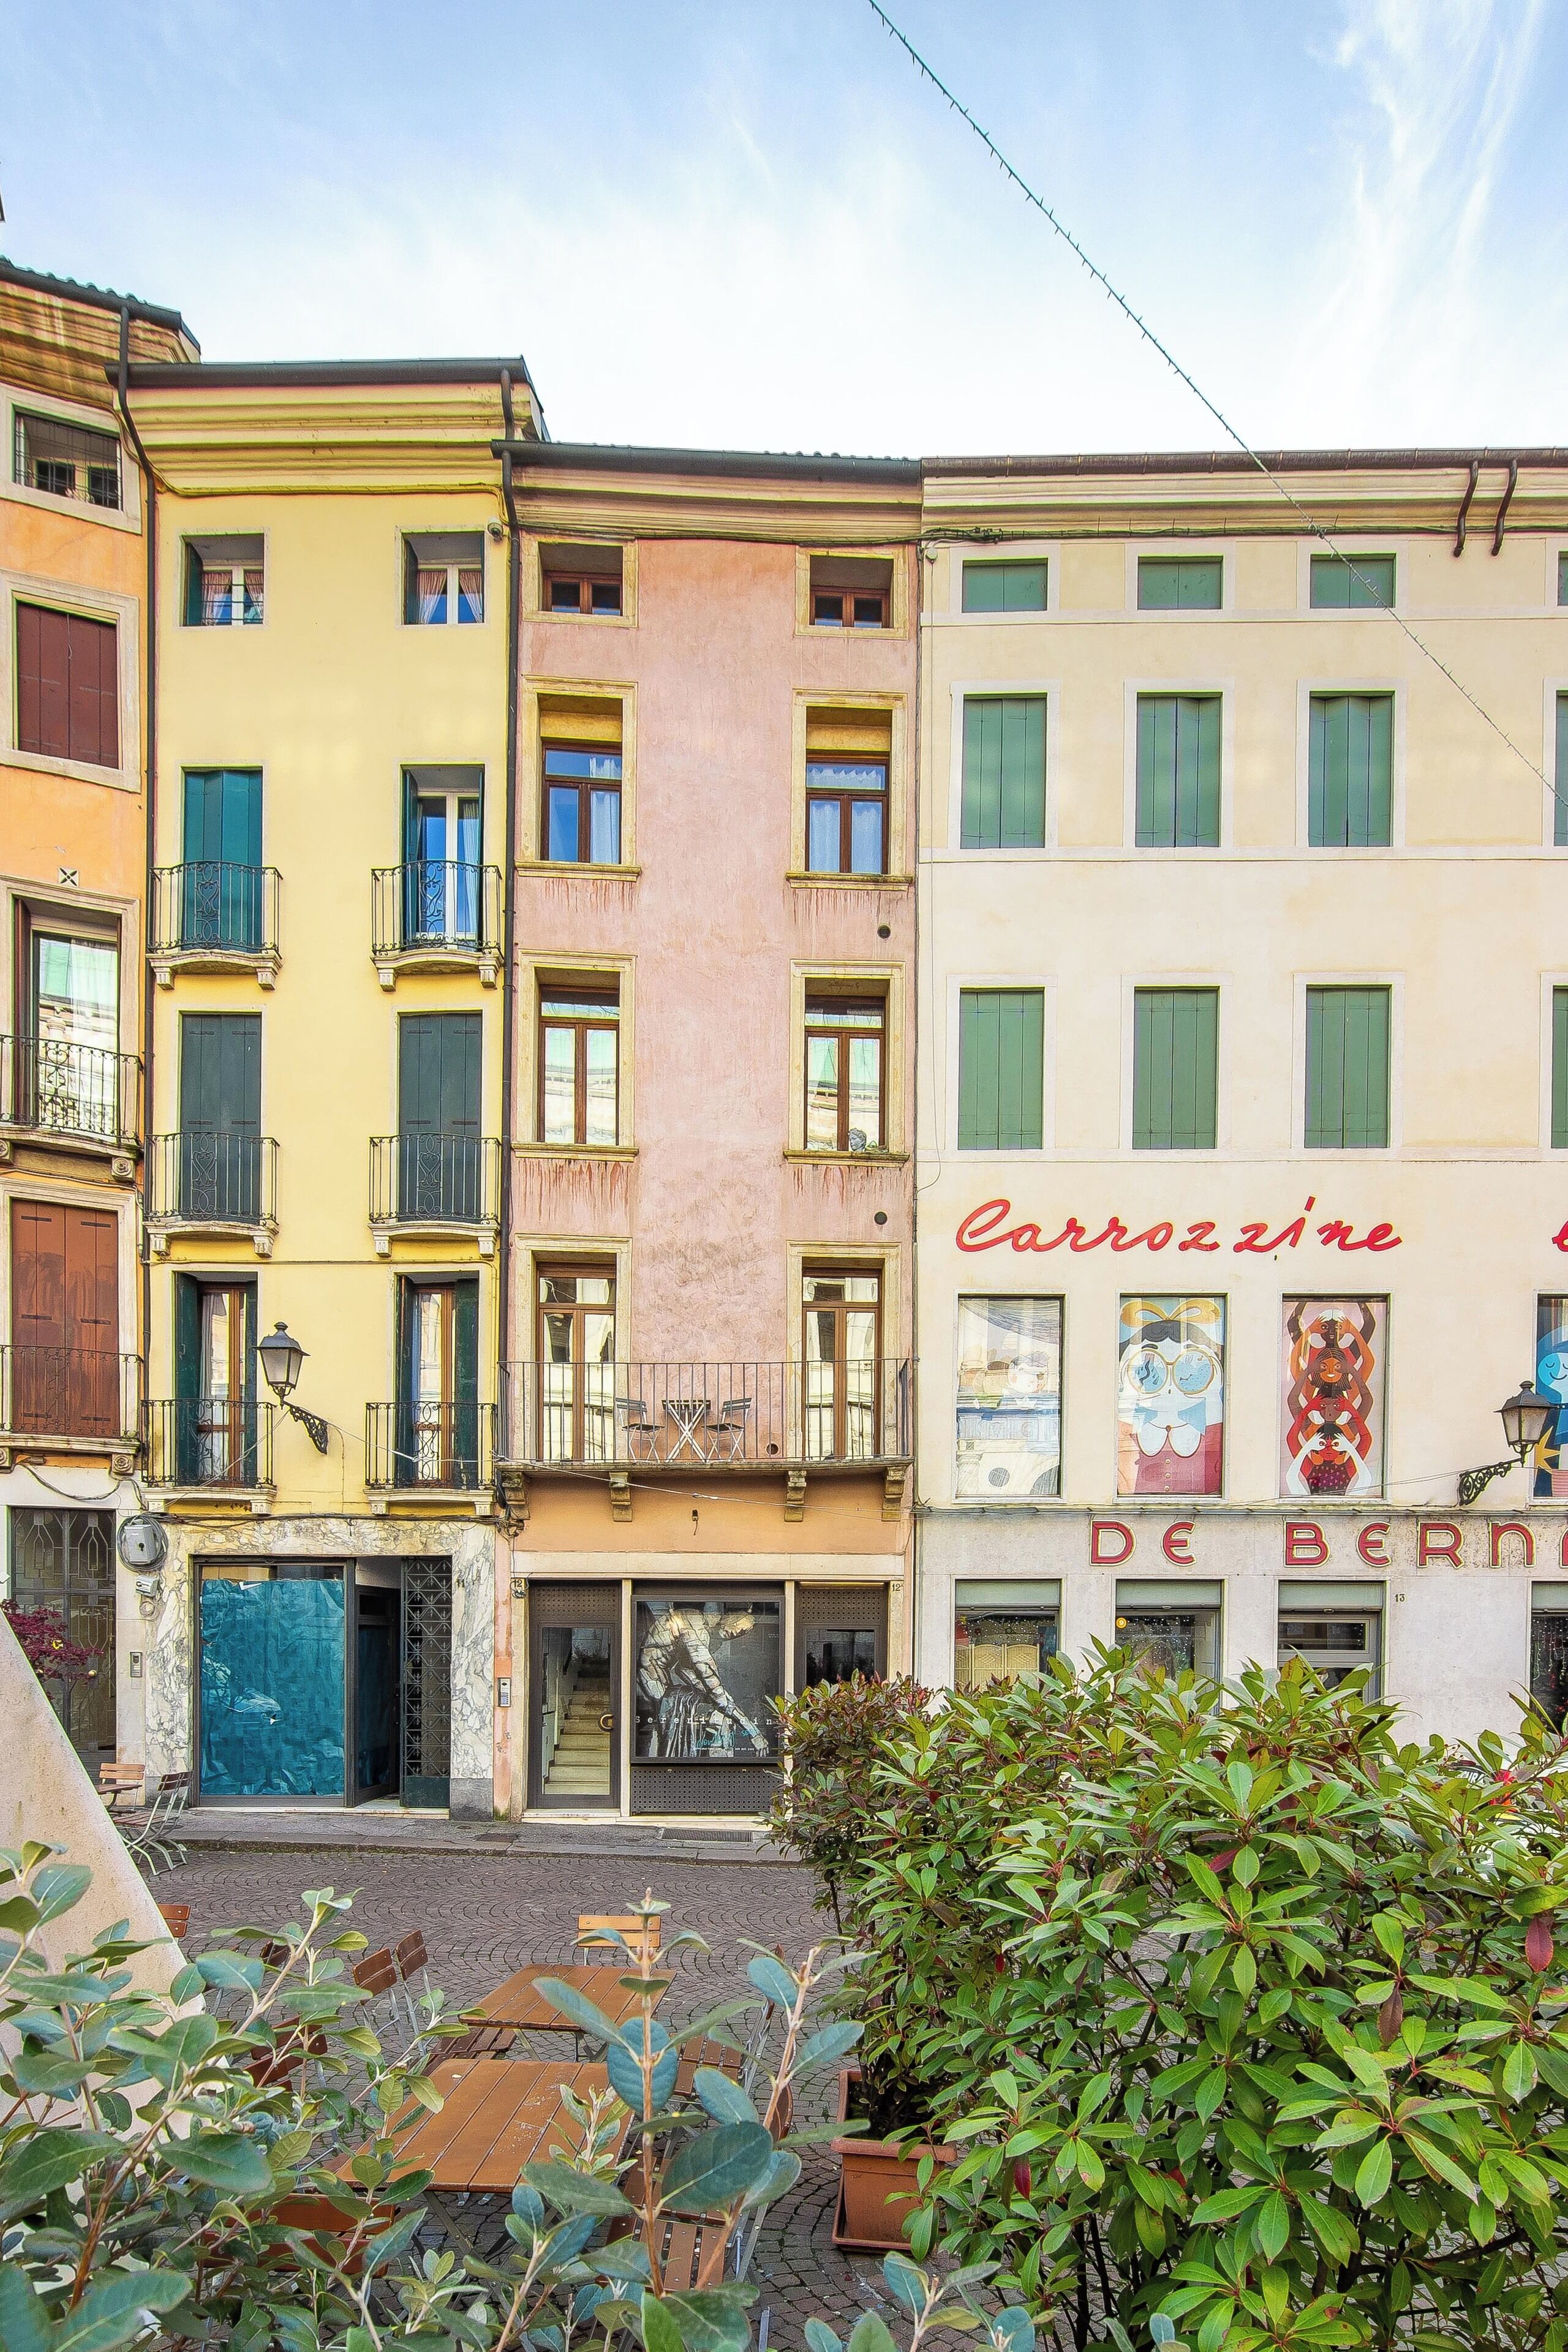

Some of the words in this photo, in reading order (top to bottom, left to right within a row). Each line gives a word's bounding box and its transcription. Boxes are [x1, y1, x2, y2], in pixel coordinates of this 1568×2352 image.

[956, 1195, 1403, 1253] Carrozzine
[1090, 1520, 1197, 1567] DE
[514, 1579, 522, 1588] 12
[1395, 1593, 1405, 1602] 13
